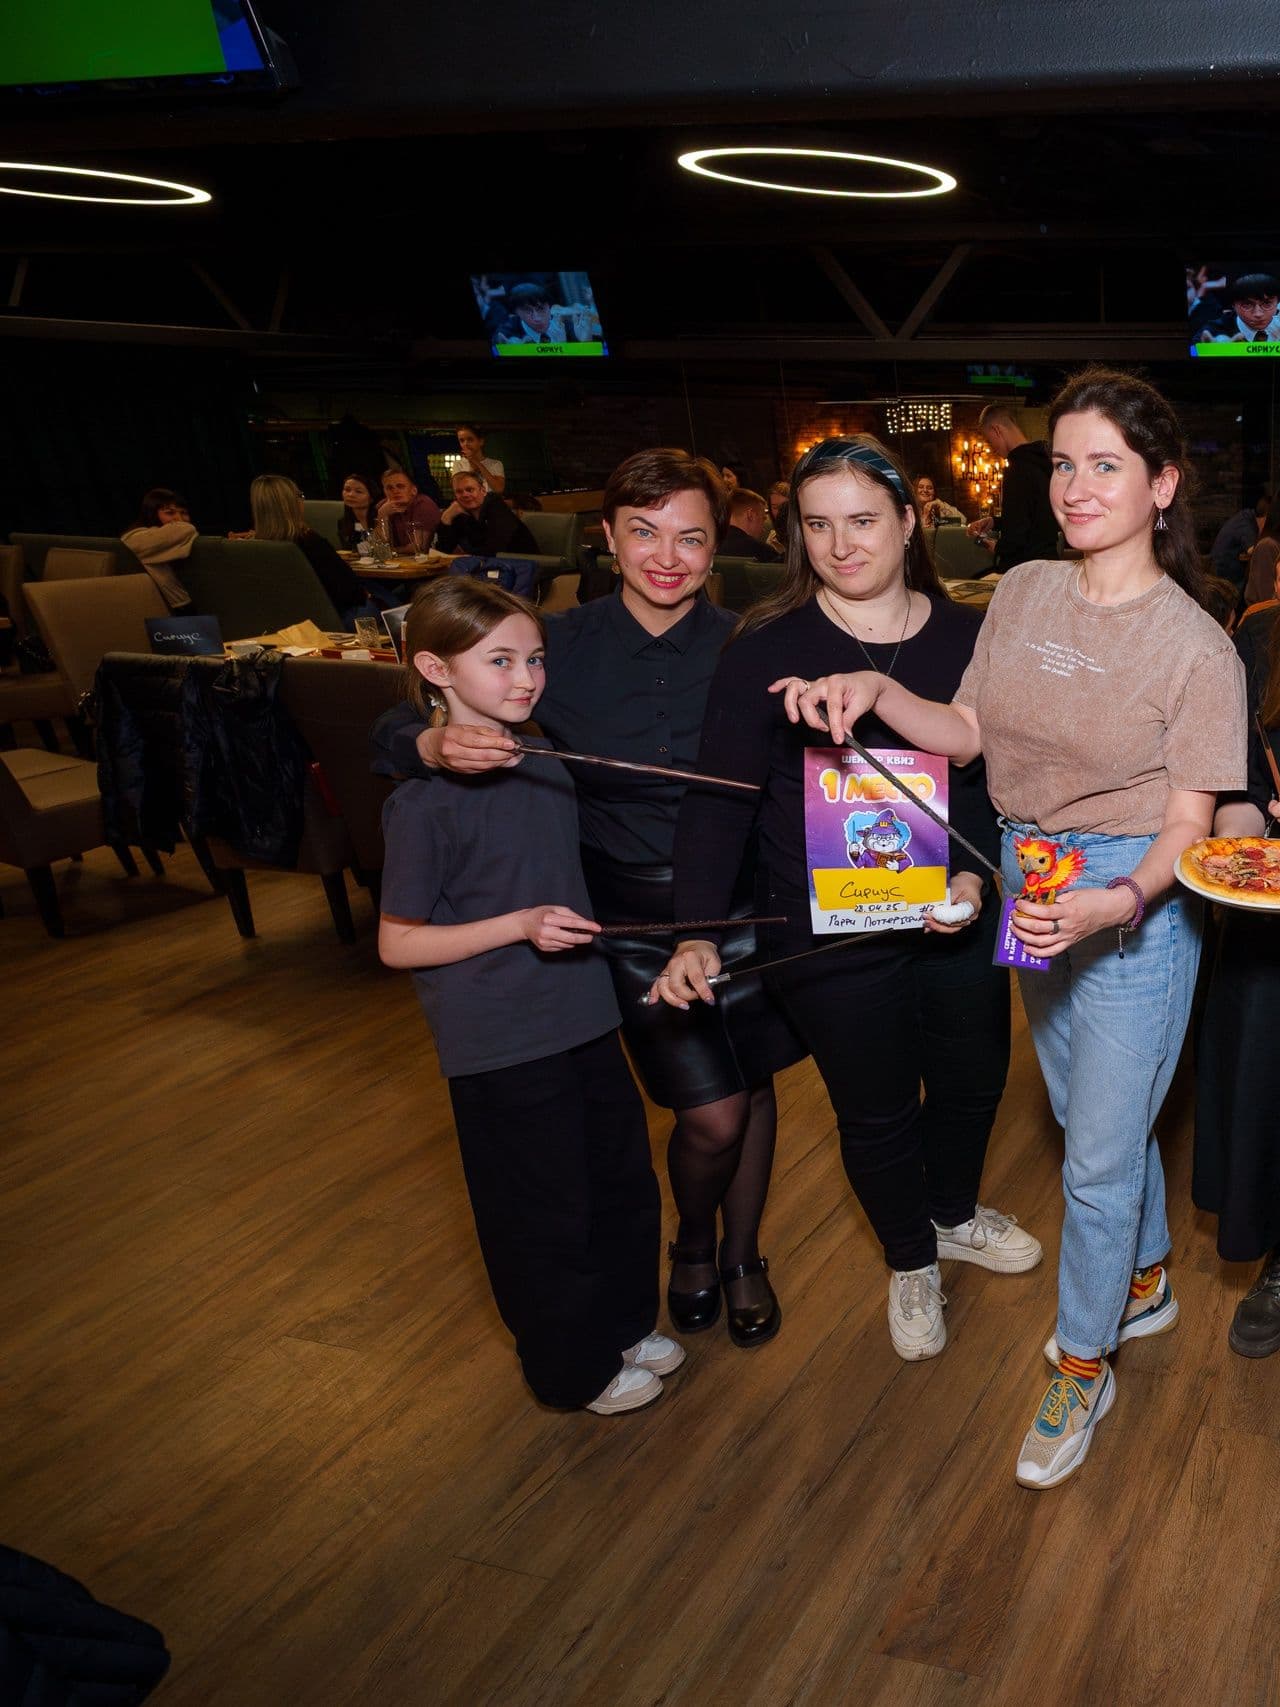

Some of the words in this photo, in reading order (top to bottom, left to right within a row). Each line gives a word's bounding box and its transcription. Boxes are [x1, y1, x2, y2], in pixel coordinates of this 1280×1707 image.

[1246, 345, 1280, 353] СИРИУС
[886, 756, 915, 765] КВИЗ
[821, 769, 840, 802] 1
[840, 881, 904, 901] Сириус
